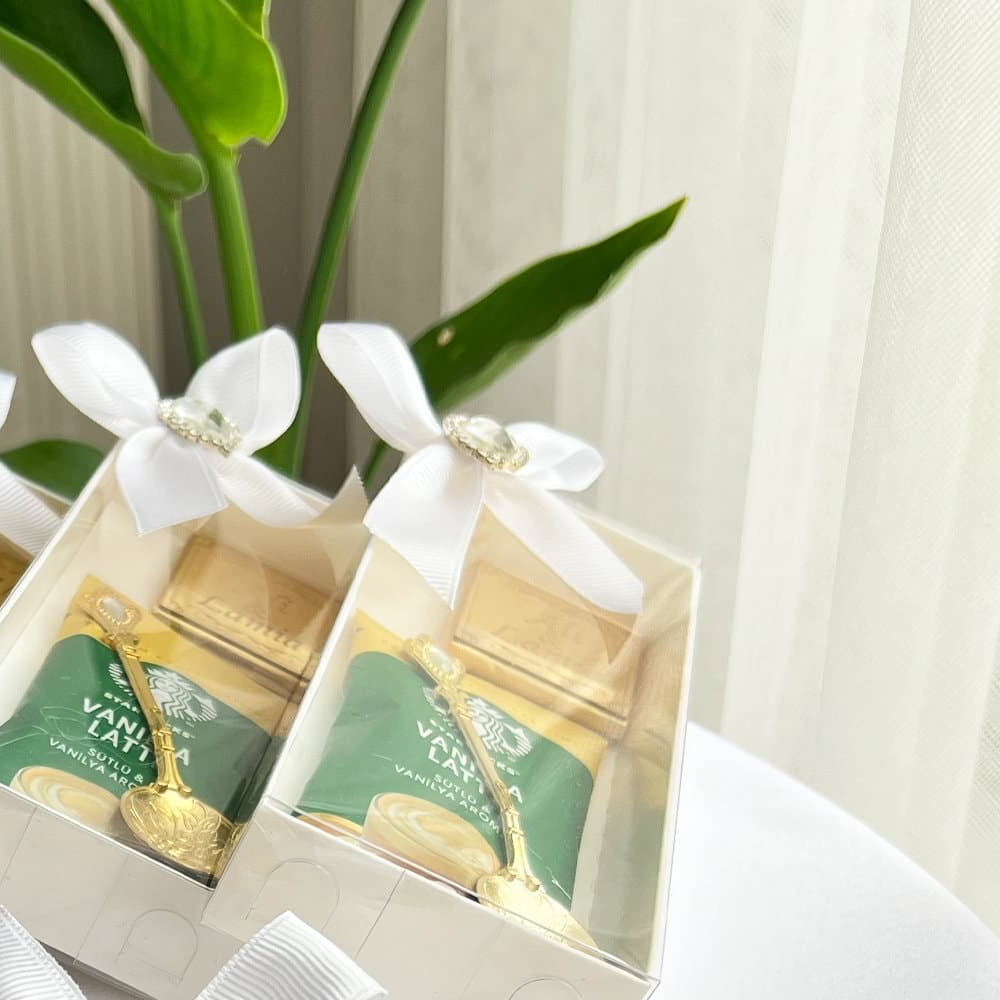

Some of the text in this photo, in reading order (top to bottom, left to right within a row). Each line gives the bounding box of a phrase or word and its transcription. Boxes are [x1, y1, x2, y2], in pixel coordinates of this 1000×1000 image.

[83, 697, 190, 767] VANIA
[87, 719, 151, 763] LATT
[416, 720, 523, 804] VANIA
[427, 746, 486, 795] LATT
